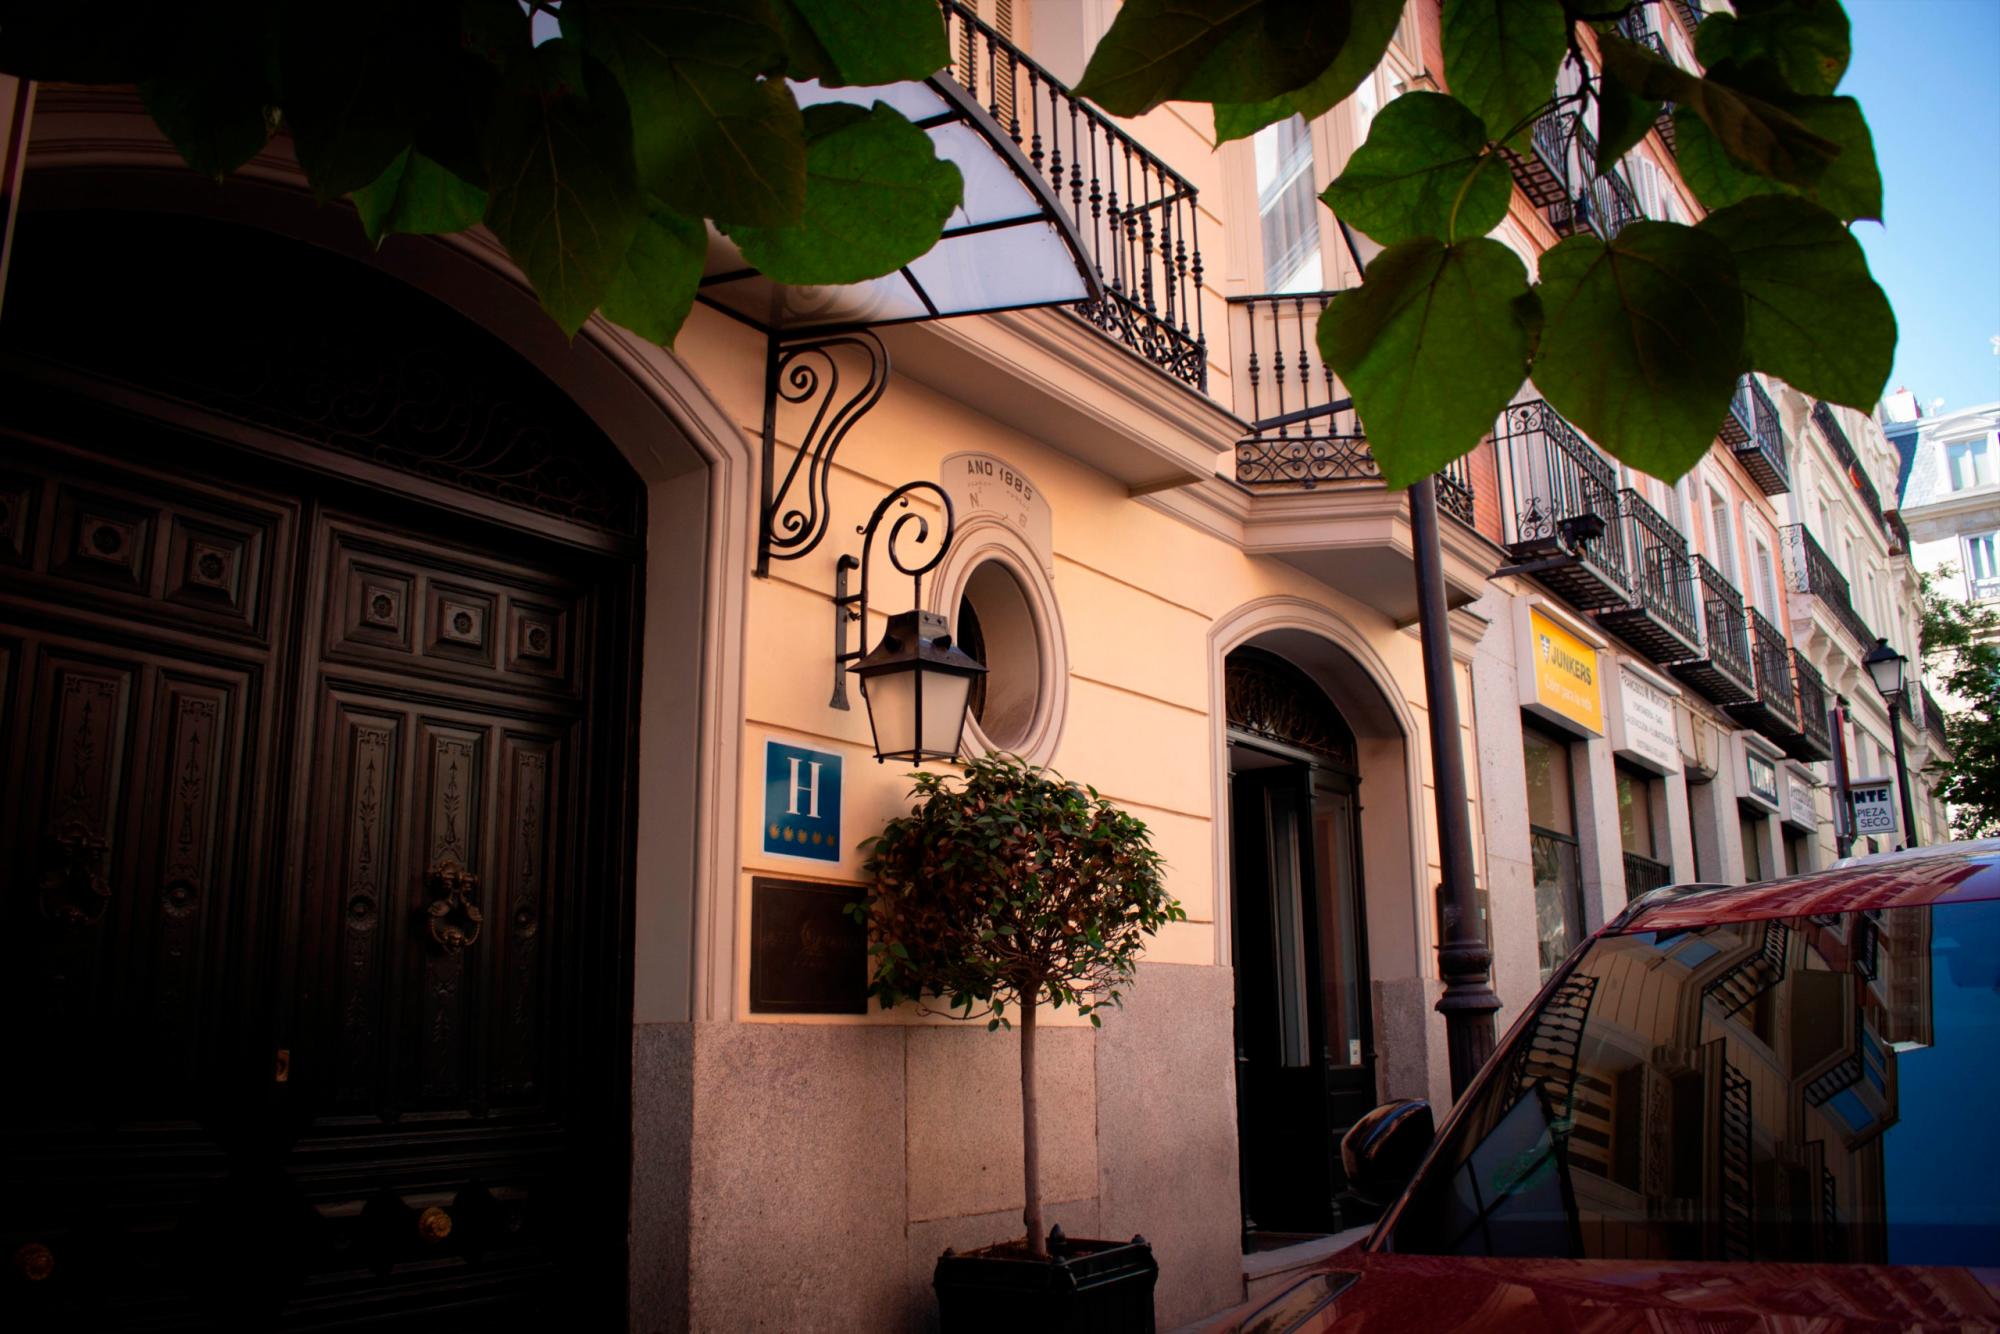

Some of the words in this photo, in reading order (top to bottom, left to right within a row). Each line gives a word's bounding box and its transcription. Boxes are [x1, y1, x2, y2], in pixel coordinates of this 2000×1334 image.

[1551, 646, 1592, 686] JUNKERS
[786, 757, 822, 818] H
[1860, 816, 1890, 828] SECO
